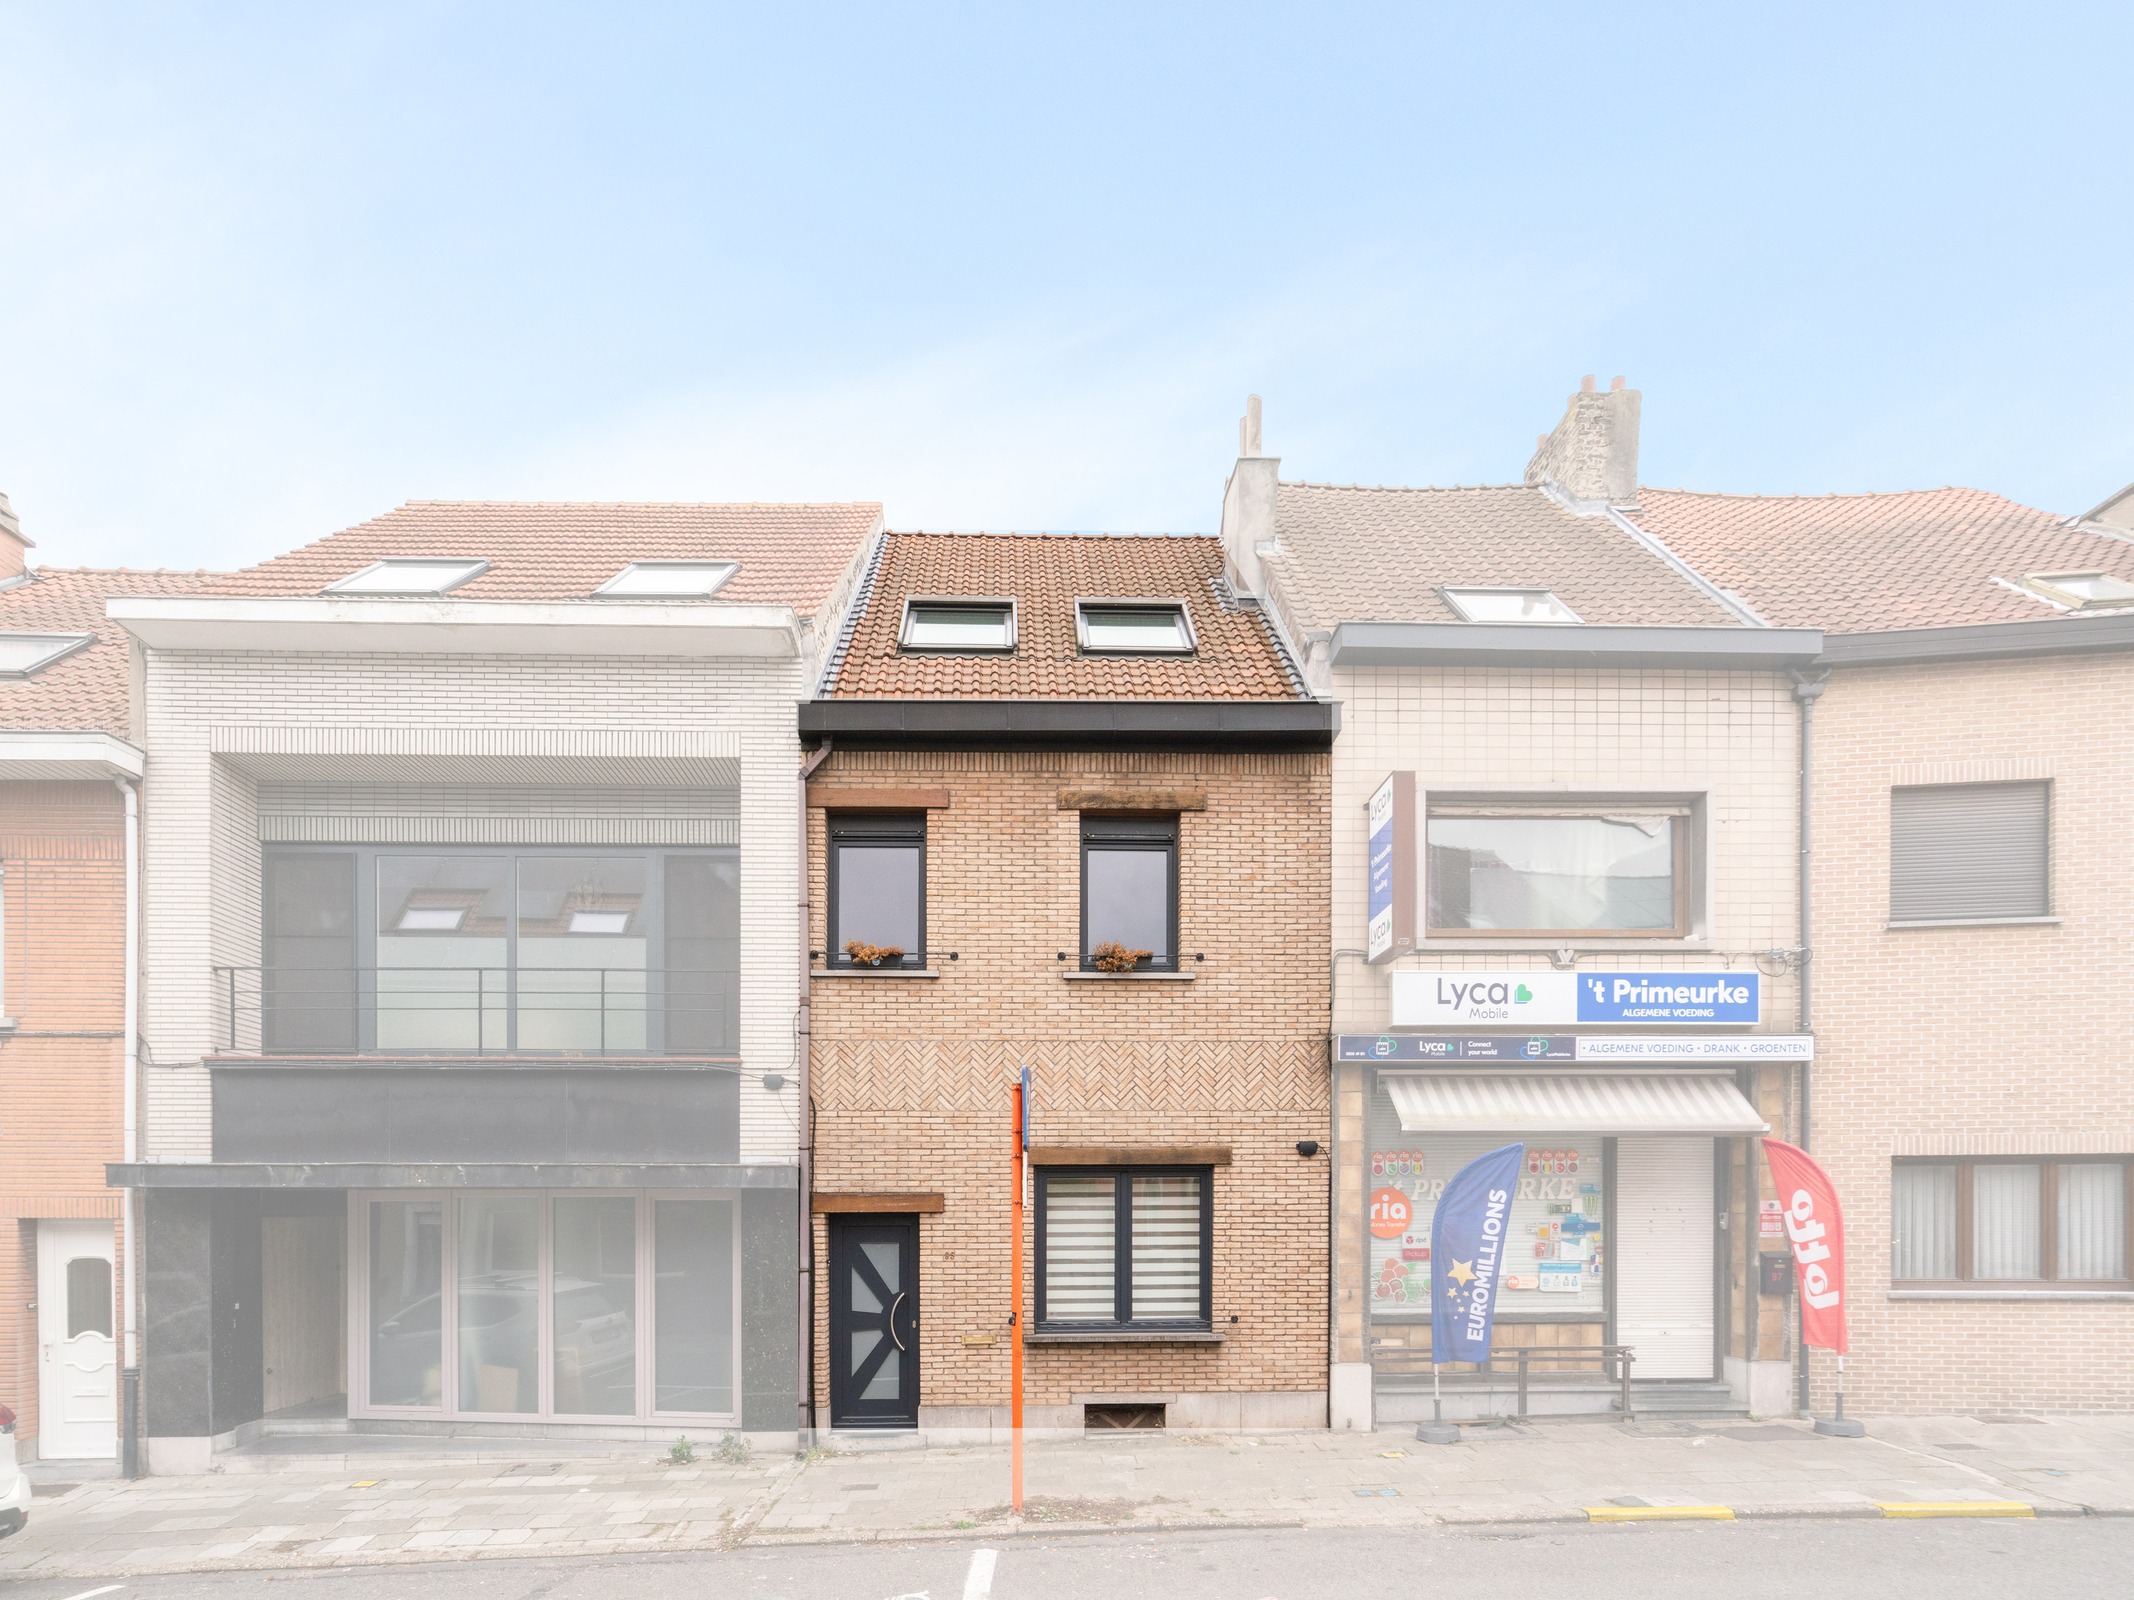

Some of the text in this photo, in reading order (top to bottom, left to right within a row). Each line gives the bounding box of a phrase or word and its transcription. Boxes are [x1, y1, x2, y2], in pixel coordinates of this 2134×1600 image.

[1370, 792, 1386, 821] Lyca
[1370, 922, 1385, 946] Lyca
[1437, 977, 1509, 1011] Lyca
[1587, 978, 1750, 1004] 't Primeurke
[1469, 1008, 1509, 1019] Mobile
[1622, 1008, 1715, 1018] ALGEMENE VOEDING
[1419, 1041, 1446, 1055] Lyca
[1468, 1048, 1498, 1057] your world
[1588, 1043, 1806, 1053] ALGEMENE VOEDING DRANK GROENTEN
[1412, 1177, 1577, 1200] PRRKE
[1370, 1194, 1407, 1220] ria
[1405, 1250, 1427, 1258] Pickup
[1466, 1189, 1507, 1341] EUROMILLIONS
[1507, 1277, 1519, 1285] ria
[1772, 1272, 1783, 1281] 97
